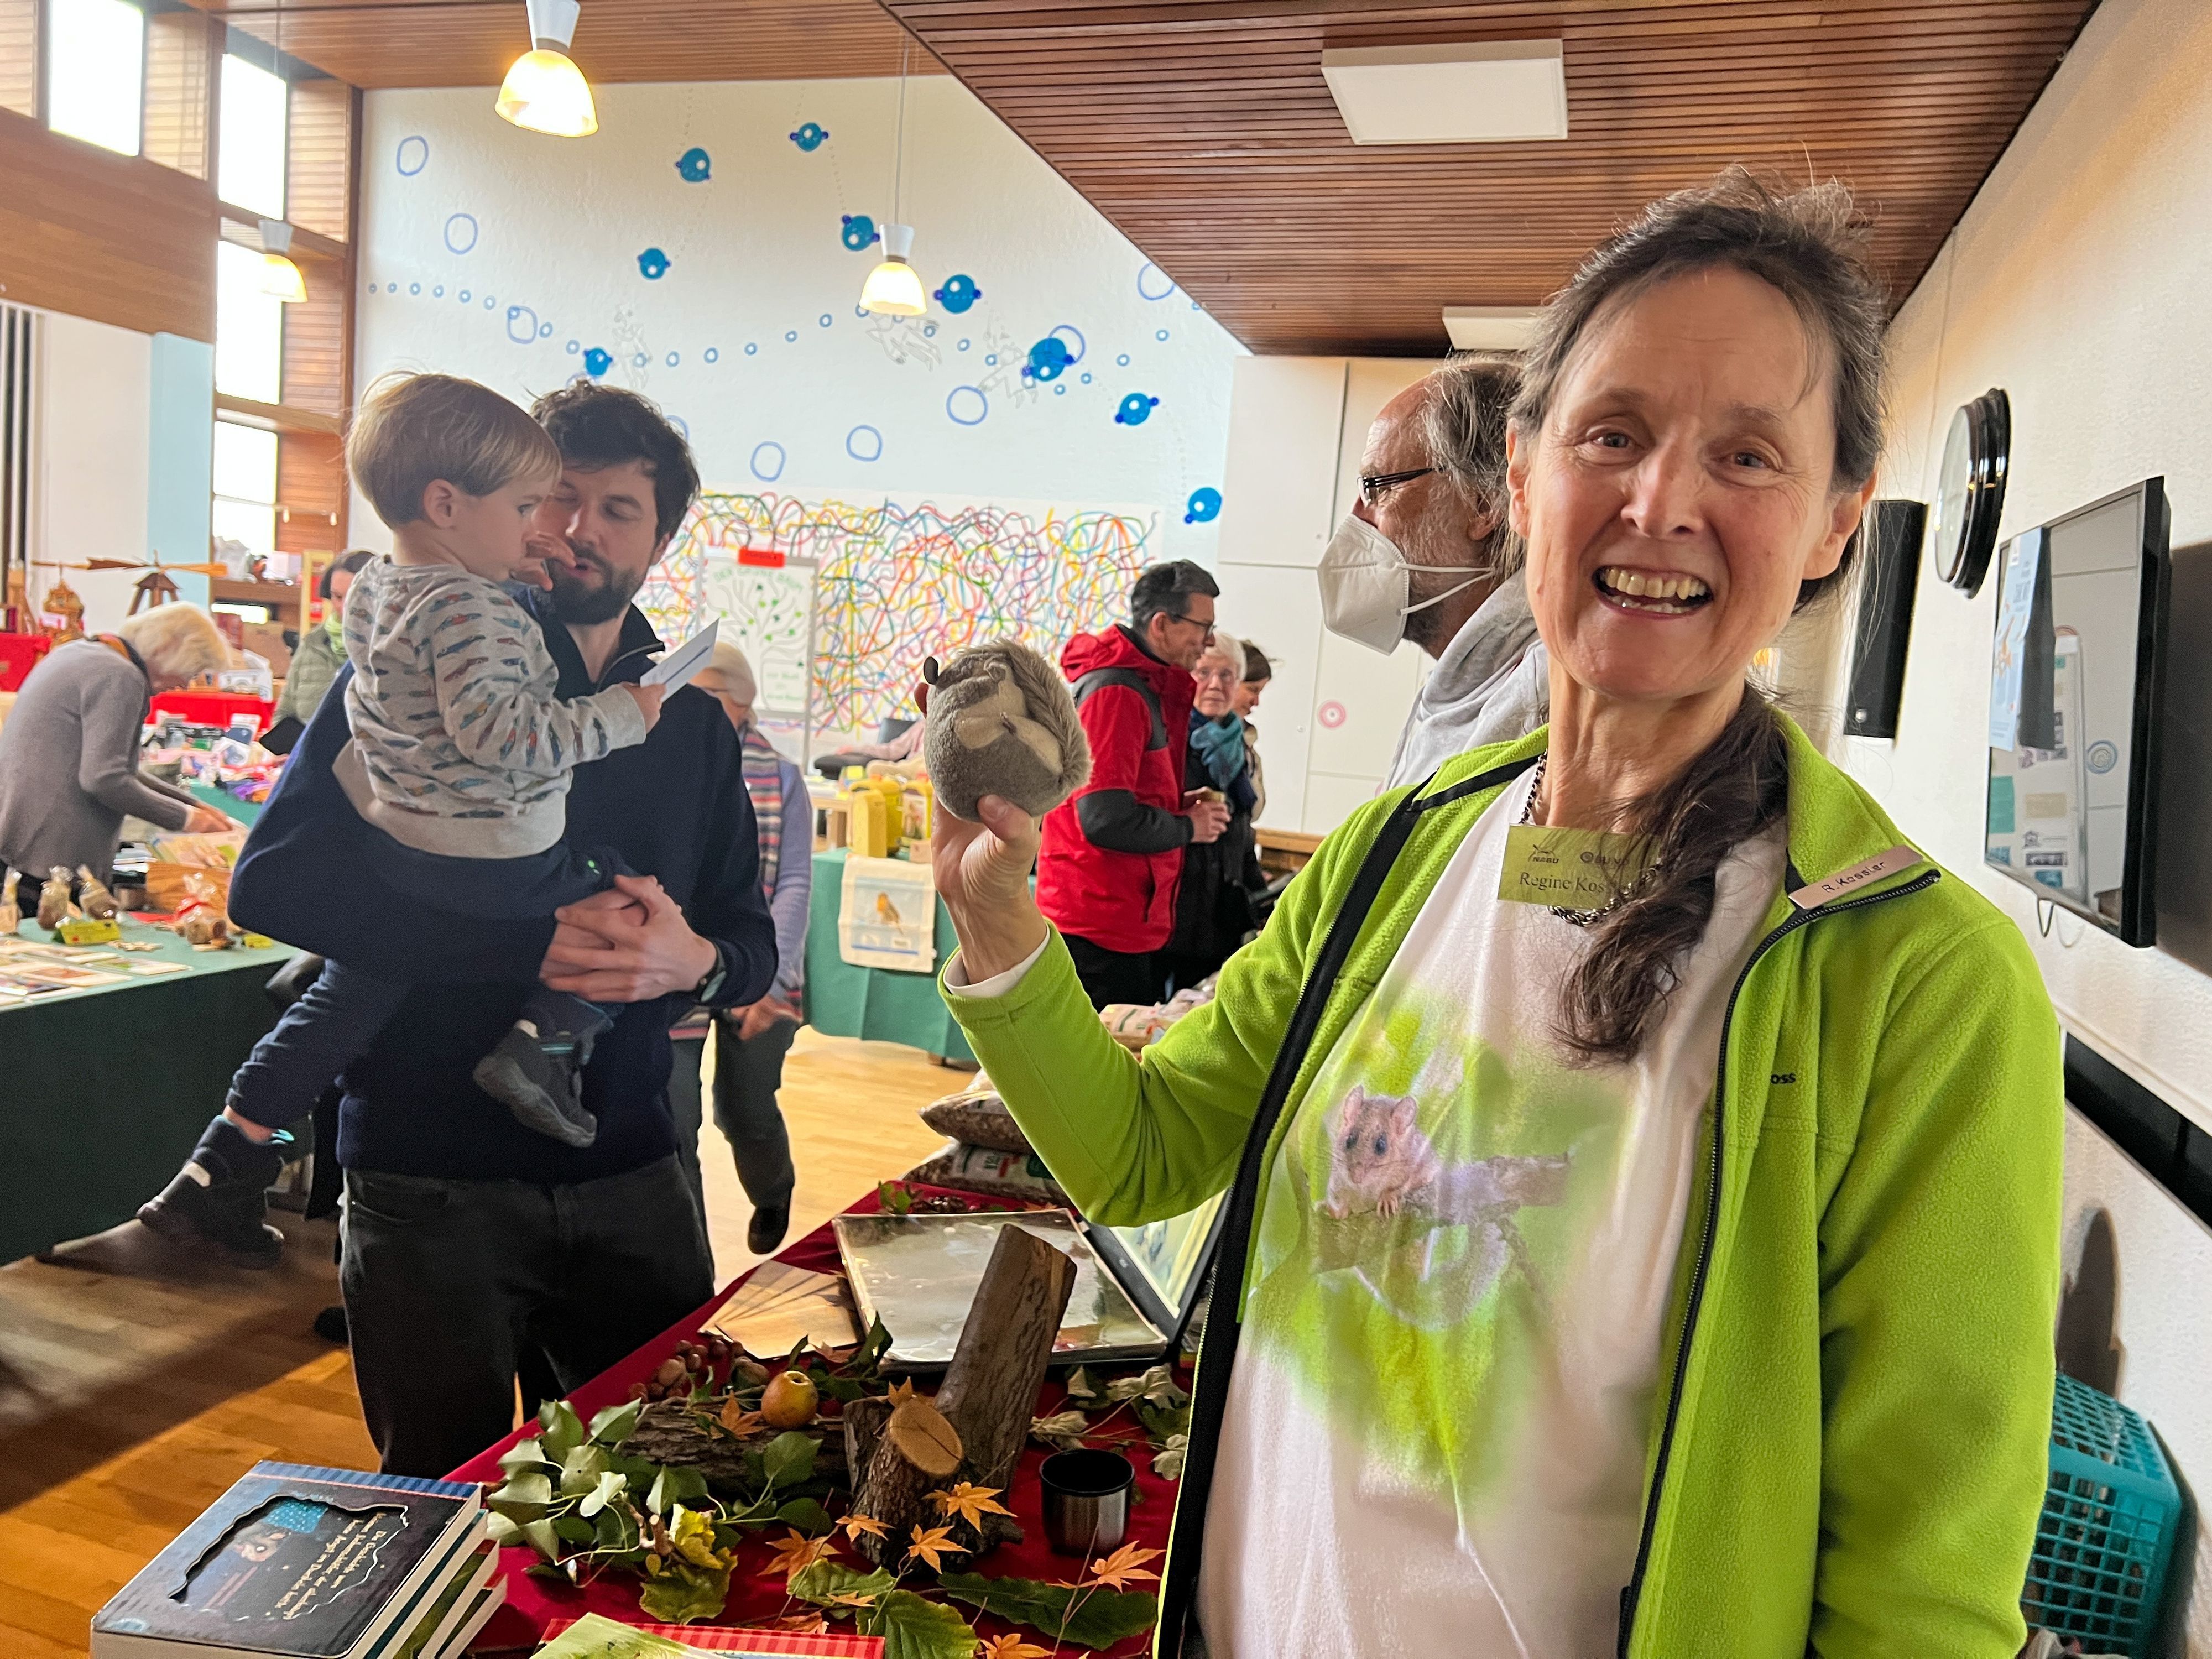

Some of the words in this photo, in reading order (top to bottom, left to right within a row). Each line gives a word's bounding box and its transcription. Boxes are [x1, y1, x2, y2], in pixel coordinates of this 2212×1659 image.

[1532, 855, 1559, 864] NABU
[1519, 872, 1571, 891] Regine
[1575, 878, 1605, 893] Kos
